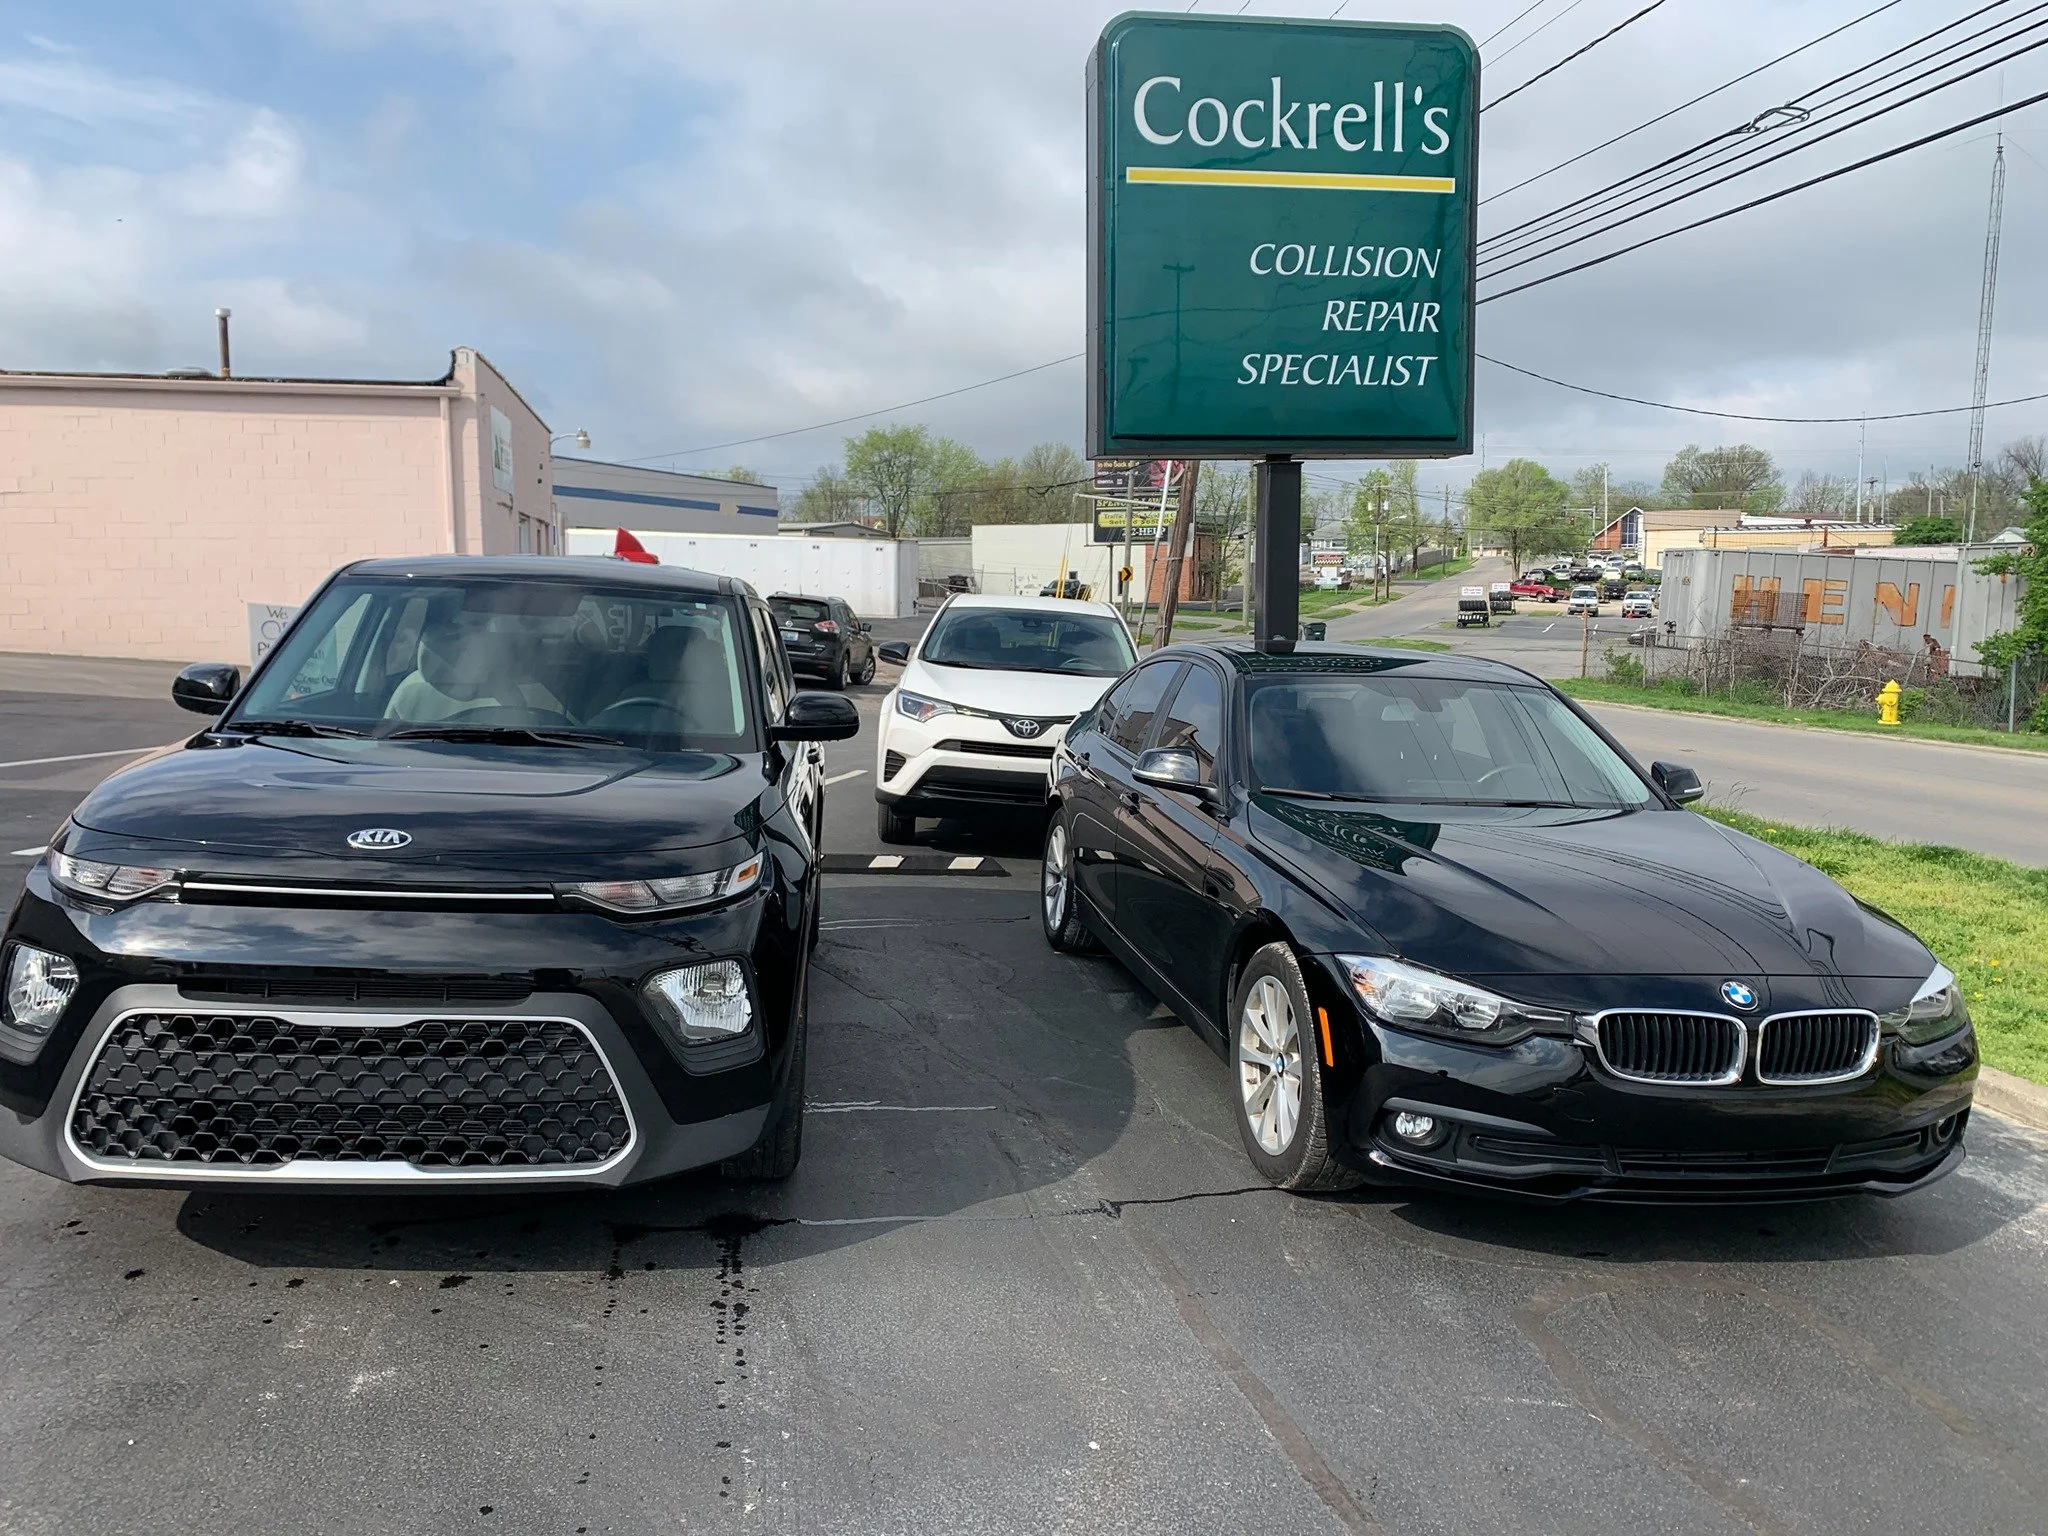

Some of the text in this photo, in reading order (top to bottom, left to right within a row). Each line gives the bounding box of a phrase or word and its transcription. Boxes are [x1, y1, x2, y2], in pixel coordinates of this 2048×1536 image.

[1133, 75, 1450, 155] Cockrell's
[1249, 243, 1441, 279] COLLISION
[1321, 300, 1440, 333] REPAIR
[1237, 353, 1438, 387] SPECIALIST
[1121, 527, 1166, 536] 22-HELP
[357, 829, 400, 844] KIA
